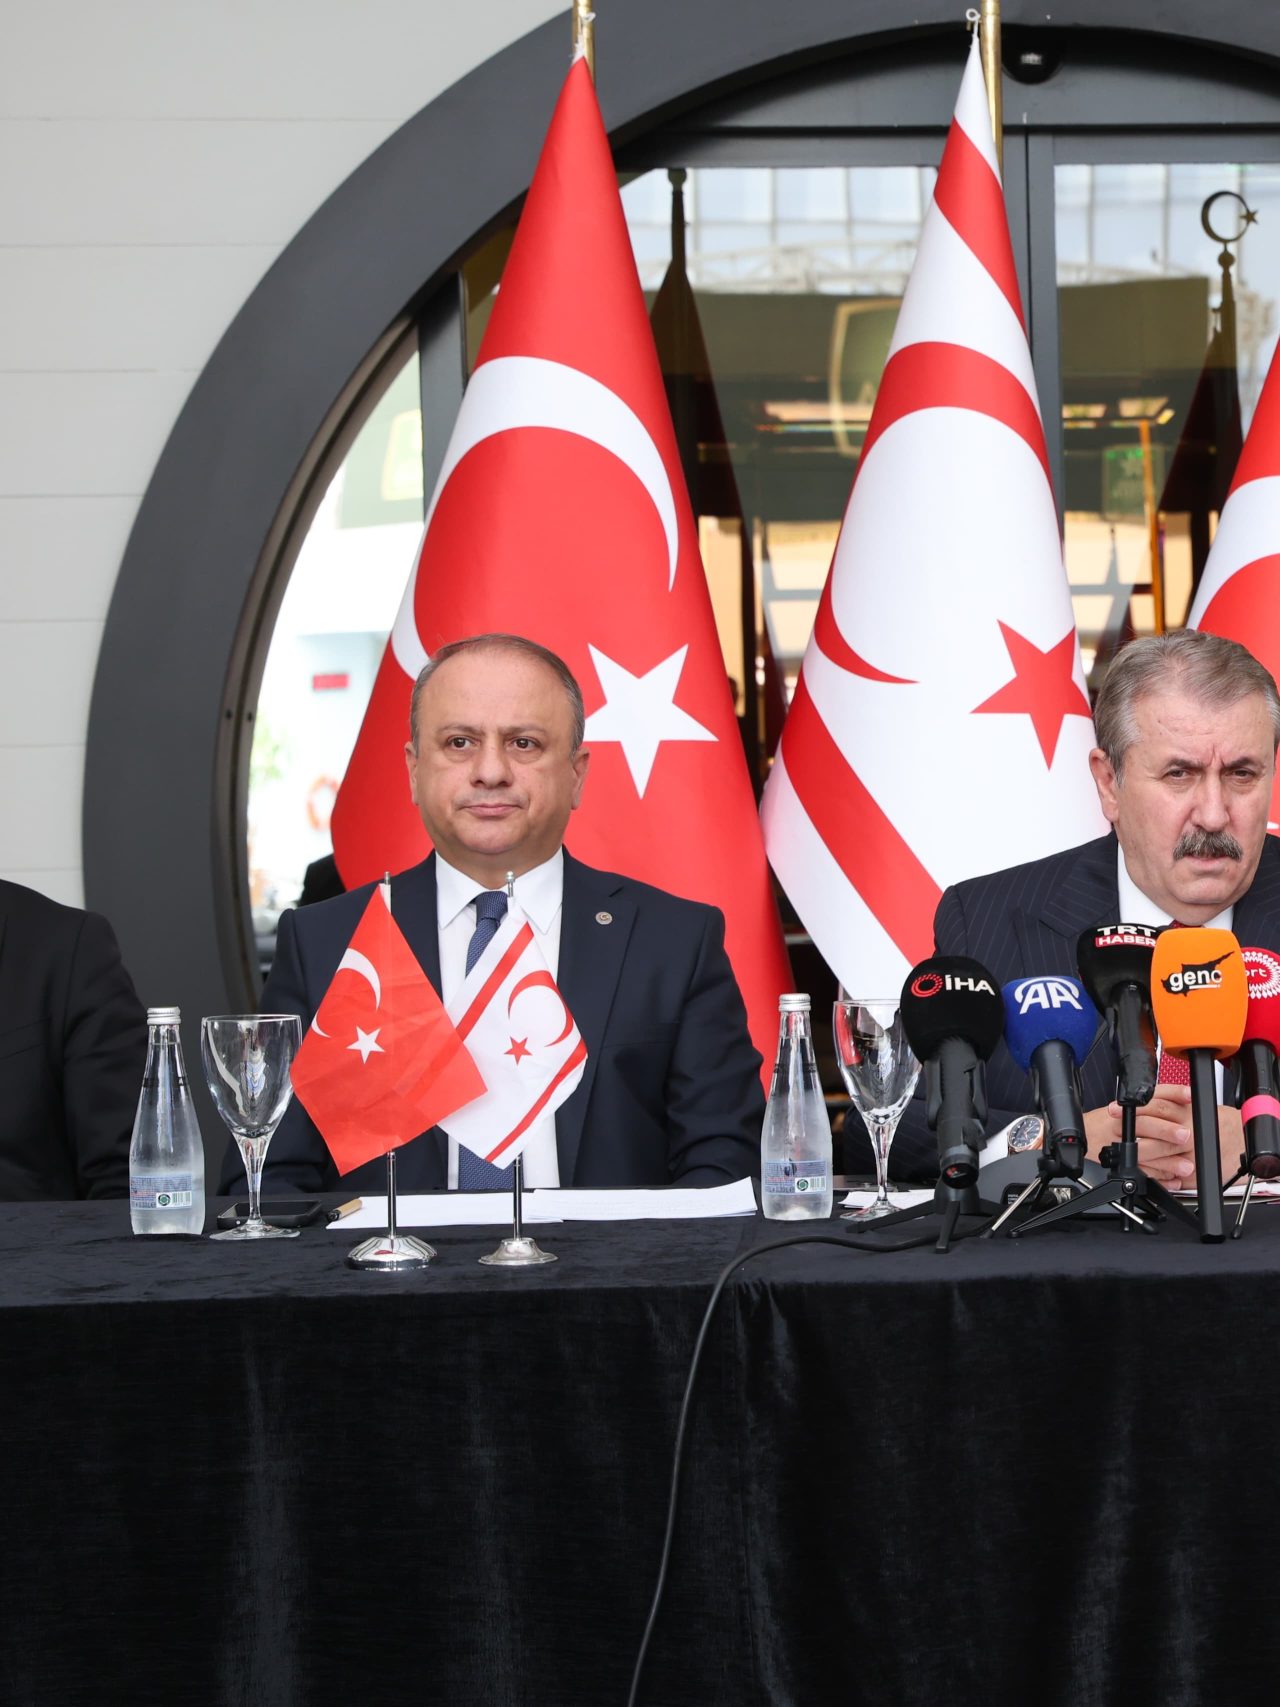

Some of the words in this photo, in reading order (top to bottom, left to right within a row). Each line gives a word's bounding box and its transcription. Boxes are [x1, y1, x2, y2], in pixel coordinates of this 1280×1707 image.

[1097, 925, 1157, 937] TRT
[1098, 935, 1156, 947] HABER
[945, 974, 995, 996] İHA
[1020, 982, 1083, 1014] AA
